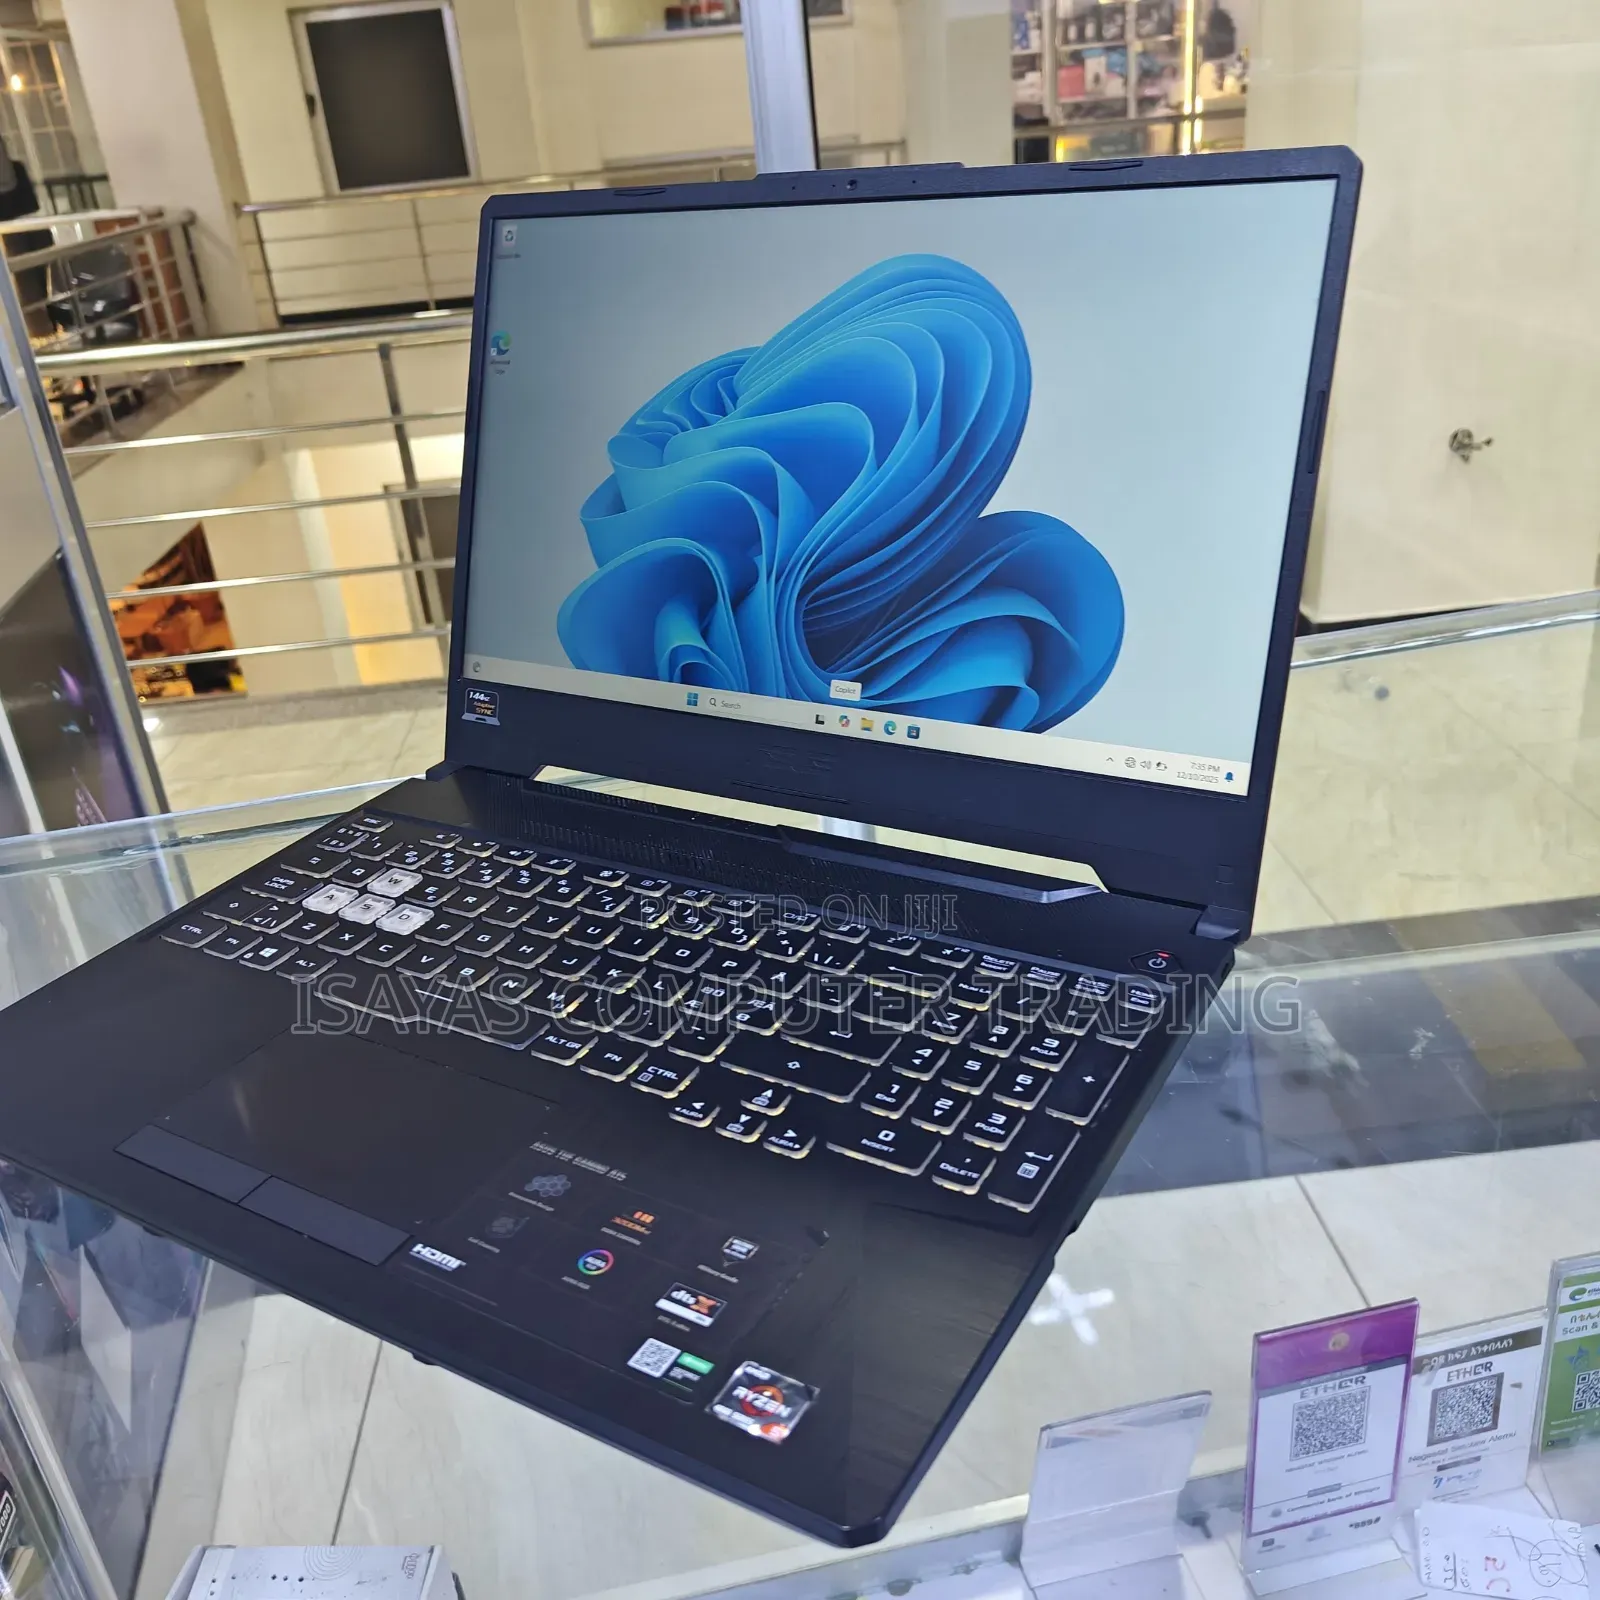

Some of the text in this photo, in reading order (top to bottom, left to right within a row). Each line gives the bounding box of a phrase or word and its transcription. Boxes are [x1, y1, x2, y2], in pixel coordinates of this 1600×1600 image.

[834, 686, 856, 695] Copilot
[720, 700, 741, 710] Search
[1191, 761, 1220, 773] 7:35 PM
[264, 881, 289, 890] LOCK
[271, 876, 295, 885] CAPS
[180, 924, 203, 935] CTRL
[225, 937, 241, 945] FN
[295, 959, 317, 968] ALT
[992, 1025, 1010, 1035] 8
[545, 1035, 582, 1050] ALT GR
[1042, 1037, 1060, 1049] 9
[603, 1052, 623, 1063] FN
[915, 1048, 934, 1057] 4
[964, 1059, 982, 1071] 5
[646, 1065, 679, 1080] CTRL
[1016, 1073, 1034, 1085] 6
[889, 1083, 901, 1094] 1
[934, 1097, 954, 1110] 2
[987, 1112, 1008, 1125] 3
[938, 1161, 981, 1179] DELETE
[1562, 1324, 1588, 1335] Scan
[731, 1386, 792, 1418] RYZEN
